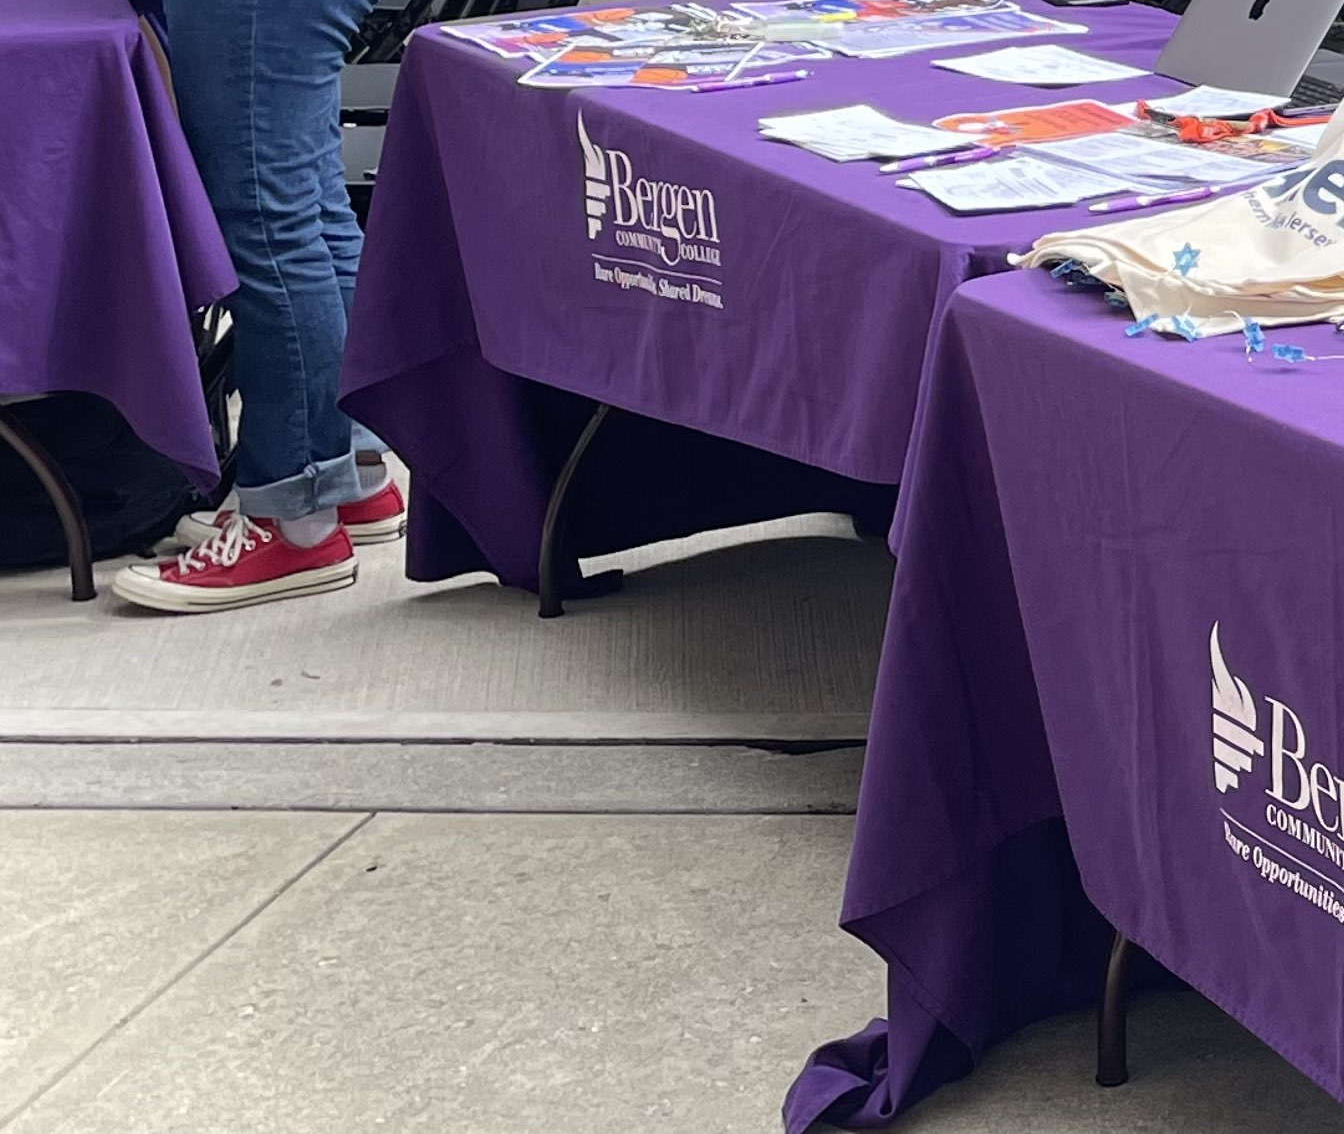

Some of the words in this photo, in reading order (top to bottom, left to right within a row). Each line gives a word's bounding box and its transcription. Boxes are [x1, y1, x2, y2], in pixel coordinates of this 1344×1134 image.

[606, 150, 720, 266] Bergen
[616, 229, 661, 255] COMMUNITY
[658, 278, 692, 301] Shared
